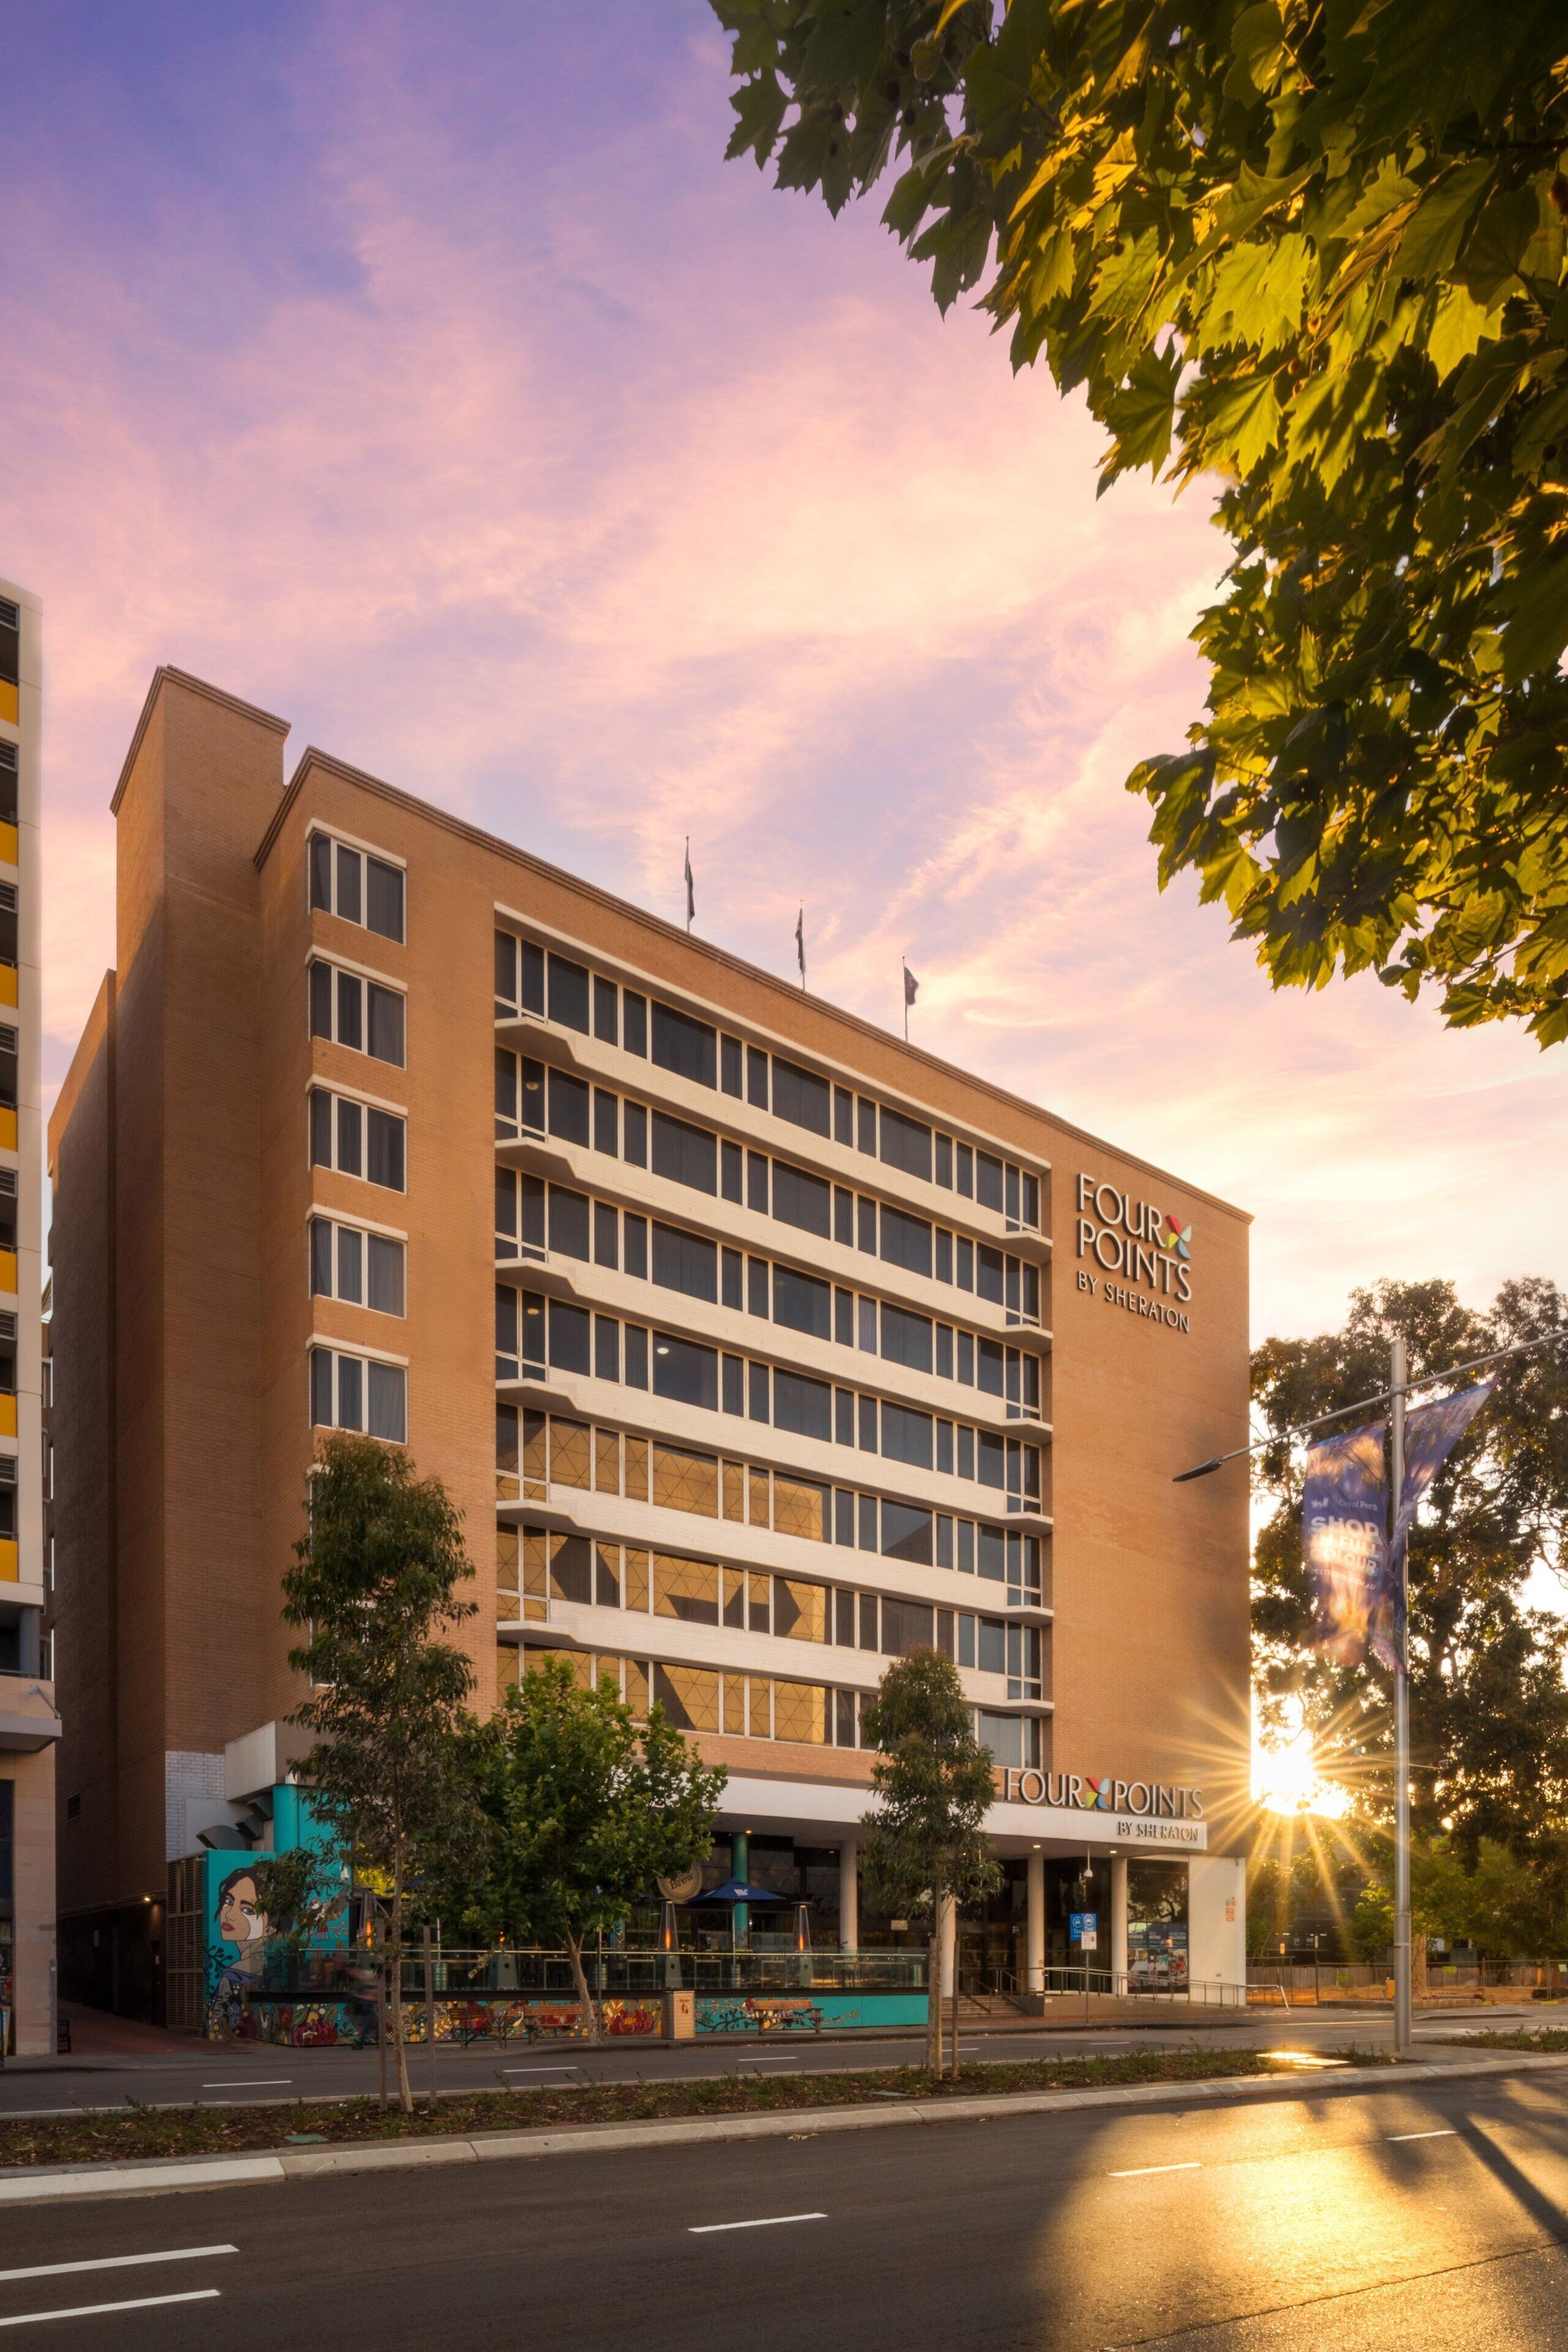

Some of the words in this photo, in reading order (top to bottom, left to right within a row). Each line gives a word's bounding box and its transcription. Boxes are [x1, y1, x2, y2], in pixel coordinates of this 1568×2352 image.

[1077, 1172, 1166, 1249] FOUR
[1077, 1218, 1192, 1302] POINTS
[1077, 1270, 1098, 1295] BY
[1104, 1282, 1189, 1333] SHERATON
[1360, 1501, 1378, 1512] Perth
[1311, 1515, 1380, 1541] SHOP
[1339, 1535, 1381, 1559] FULL
[1005, 1768, 1085, 1807] FOUR
[1112, 1781, 1204, 1819] POINTS
[1118, 1822, 1133, 1836] BY
[1137, 1823, 1198, 1841] SHERATON
[669, 1873, 694, 1890] Brew
